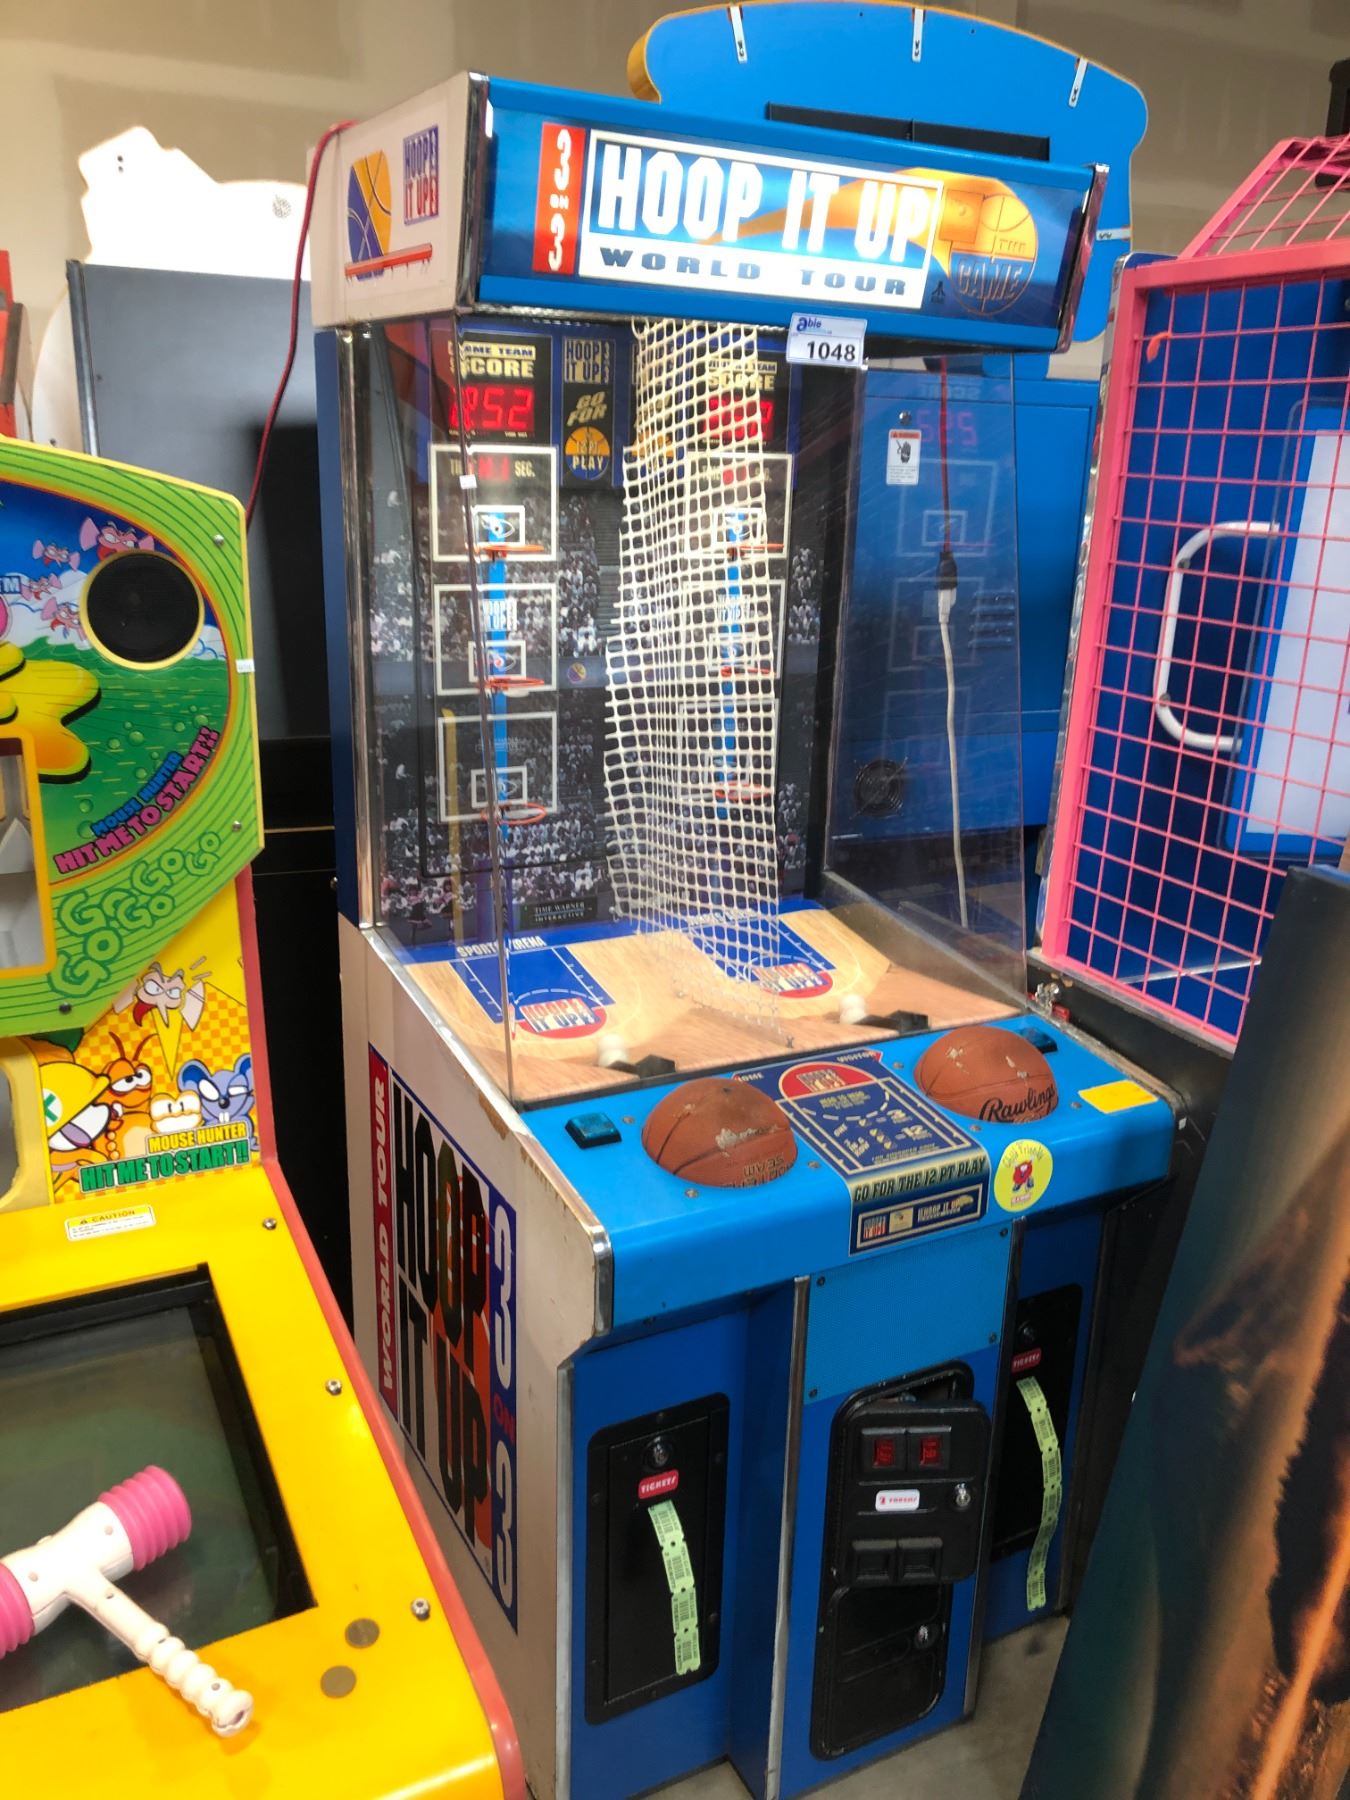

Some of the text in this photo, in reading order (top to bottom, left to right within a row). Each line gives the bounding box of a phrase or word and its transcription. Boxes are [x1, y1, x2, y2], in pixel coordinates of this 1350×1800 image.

[553, 129, 572, 191] 3
[598, 143, 929, 263] HOOP IT UP
[548, 213, 566, 271] 3
[600, 247, 906, 296] WORLD TOUR
[957, 257, 1023, 299] GAME
[807, 340, 856, 361] 1048
[572, 455, 604, 471] PLAY
[90, 750, 185, 837] MOUSE HUNTER
[53, 841, 99, 874] HIT
[95, 824, 136, 857] ME
[126, 804, 162, 836] TO
[148, 1122, 246, 1153] MOUSE HUNTER
[80, 1164, 115, 1192] HIT
[117, 1157, 149, 1185] ME
[149, 1152, 175, 1179] TO
[854, 1156, 986, 1201] GO FOR THE 12 PT PLAY
[92, 1209, 136, 1223] CAUTION
[374, 1077, 393, 1391] WORLD TOUR
[393, 1081, 488, 1375] HOOP
[494, 1204, 512, 1390] 3
[495, 1439, 513, 1609] 3
